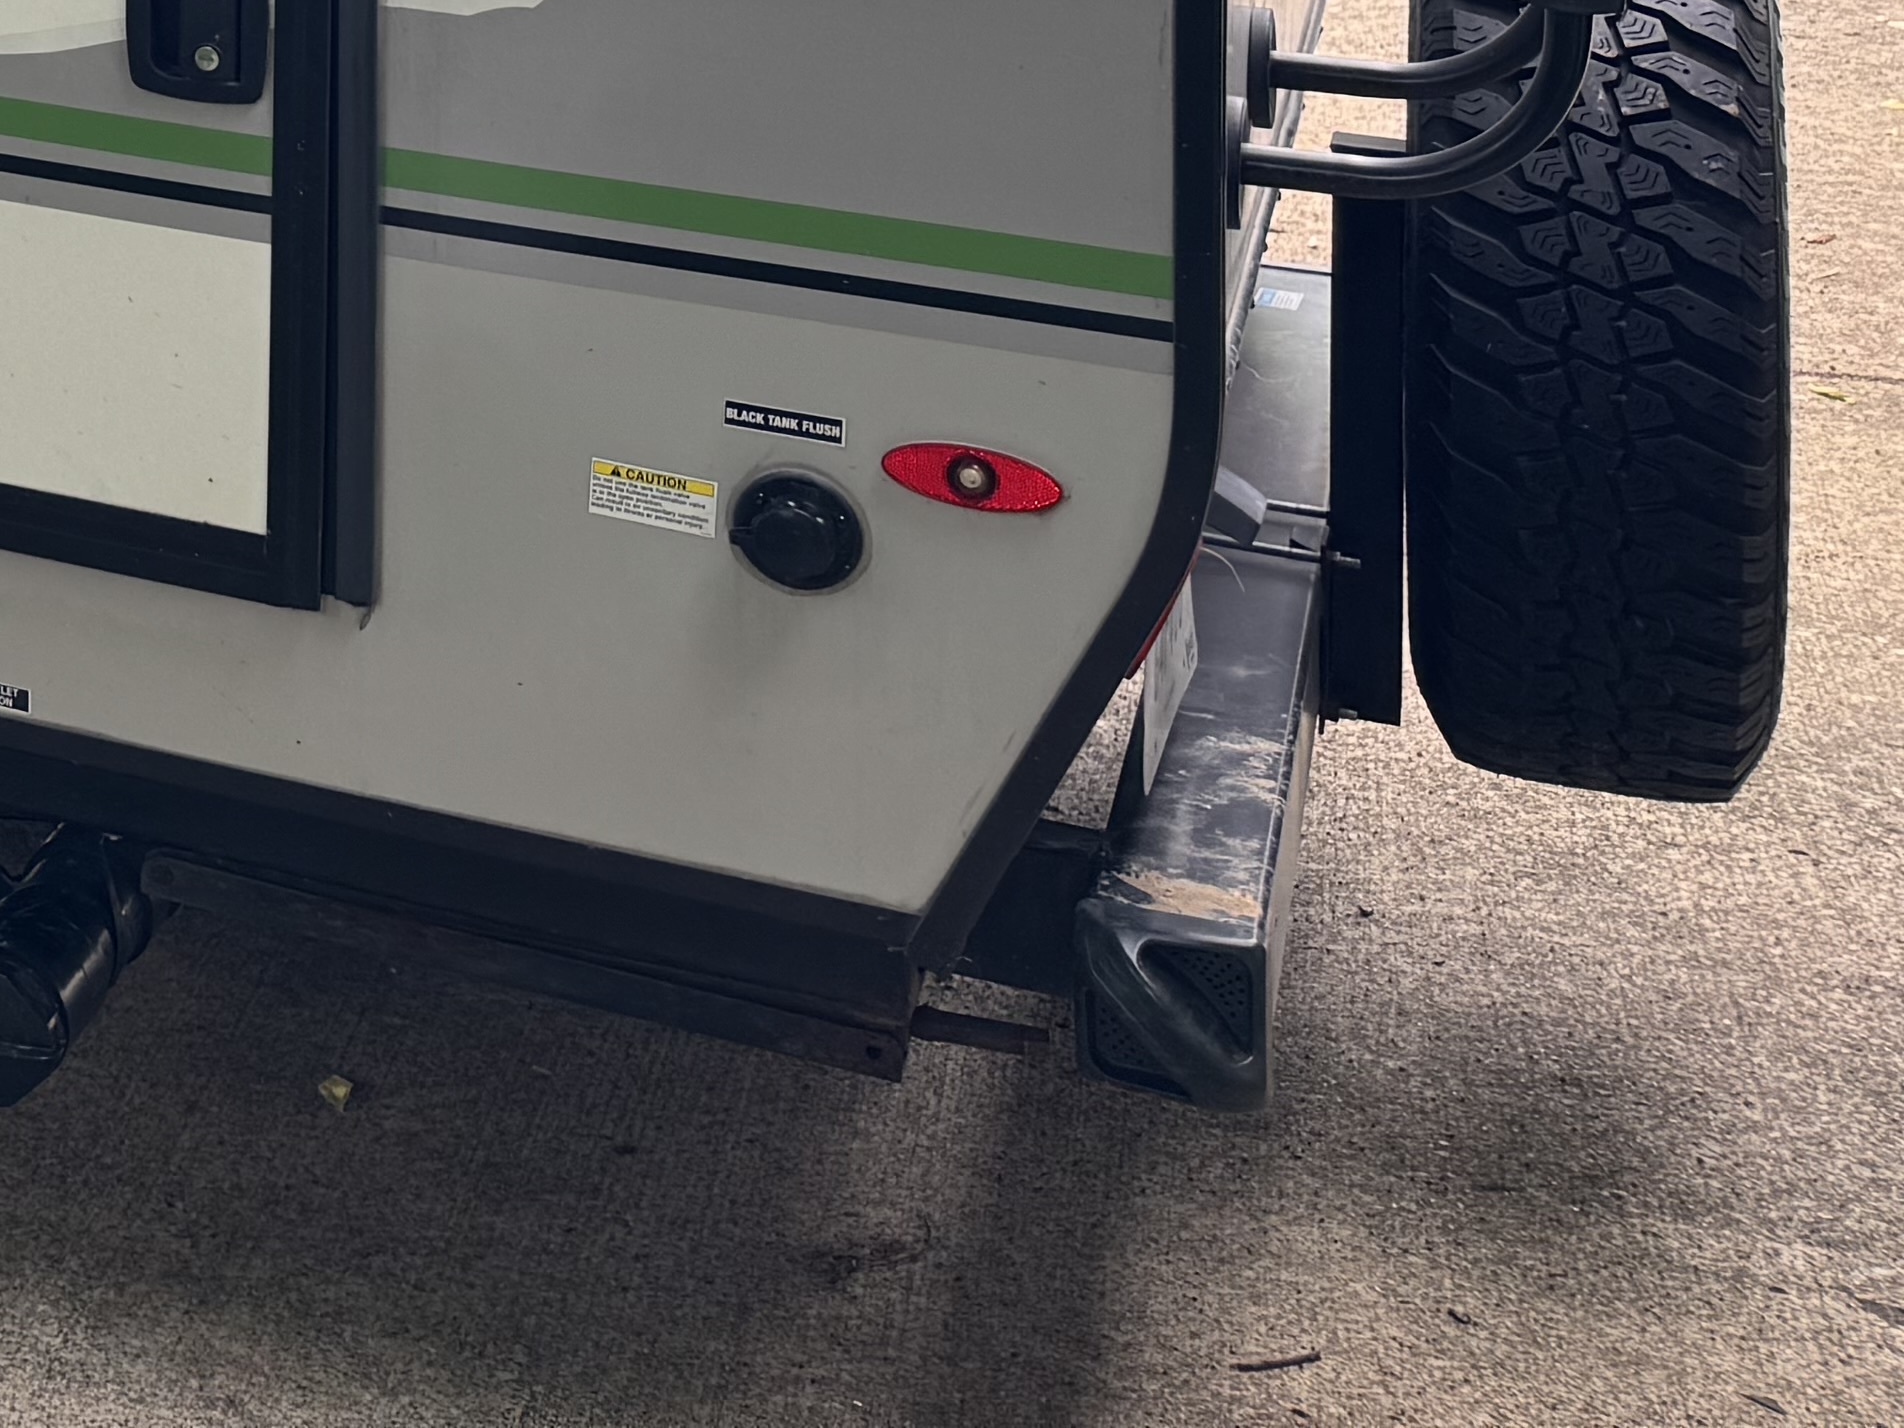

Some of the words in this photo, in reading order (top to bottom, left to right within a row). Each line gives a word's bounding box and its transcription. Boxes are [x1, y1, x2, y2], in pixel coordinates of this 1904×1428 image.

[726, 408, 764, 424] BLACK
[767, 415, 799, 430] TANK
[802, 420, 840, 437] FLUSH
[626, 468, 687, 491] CAUTION
